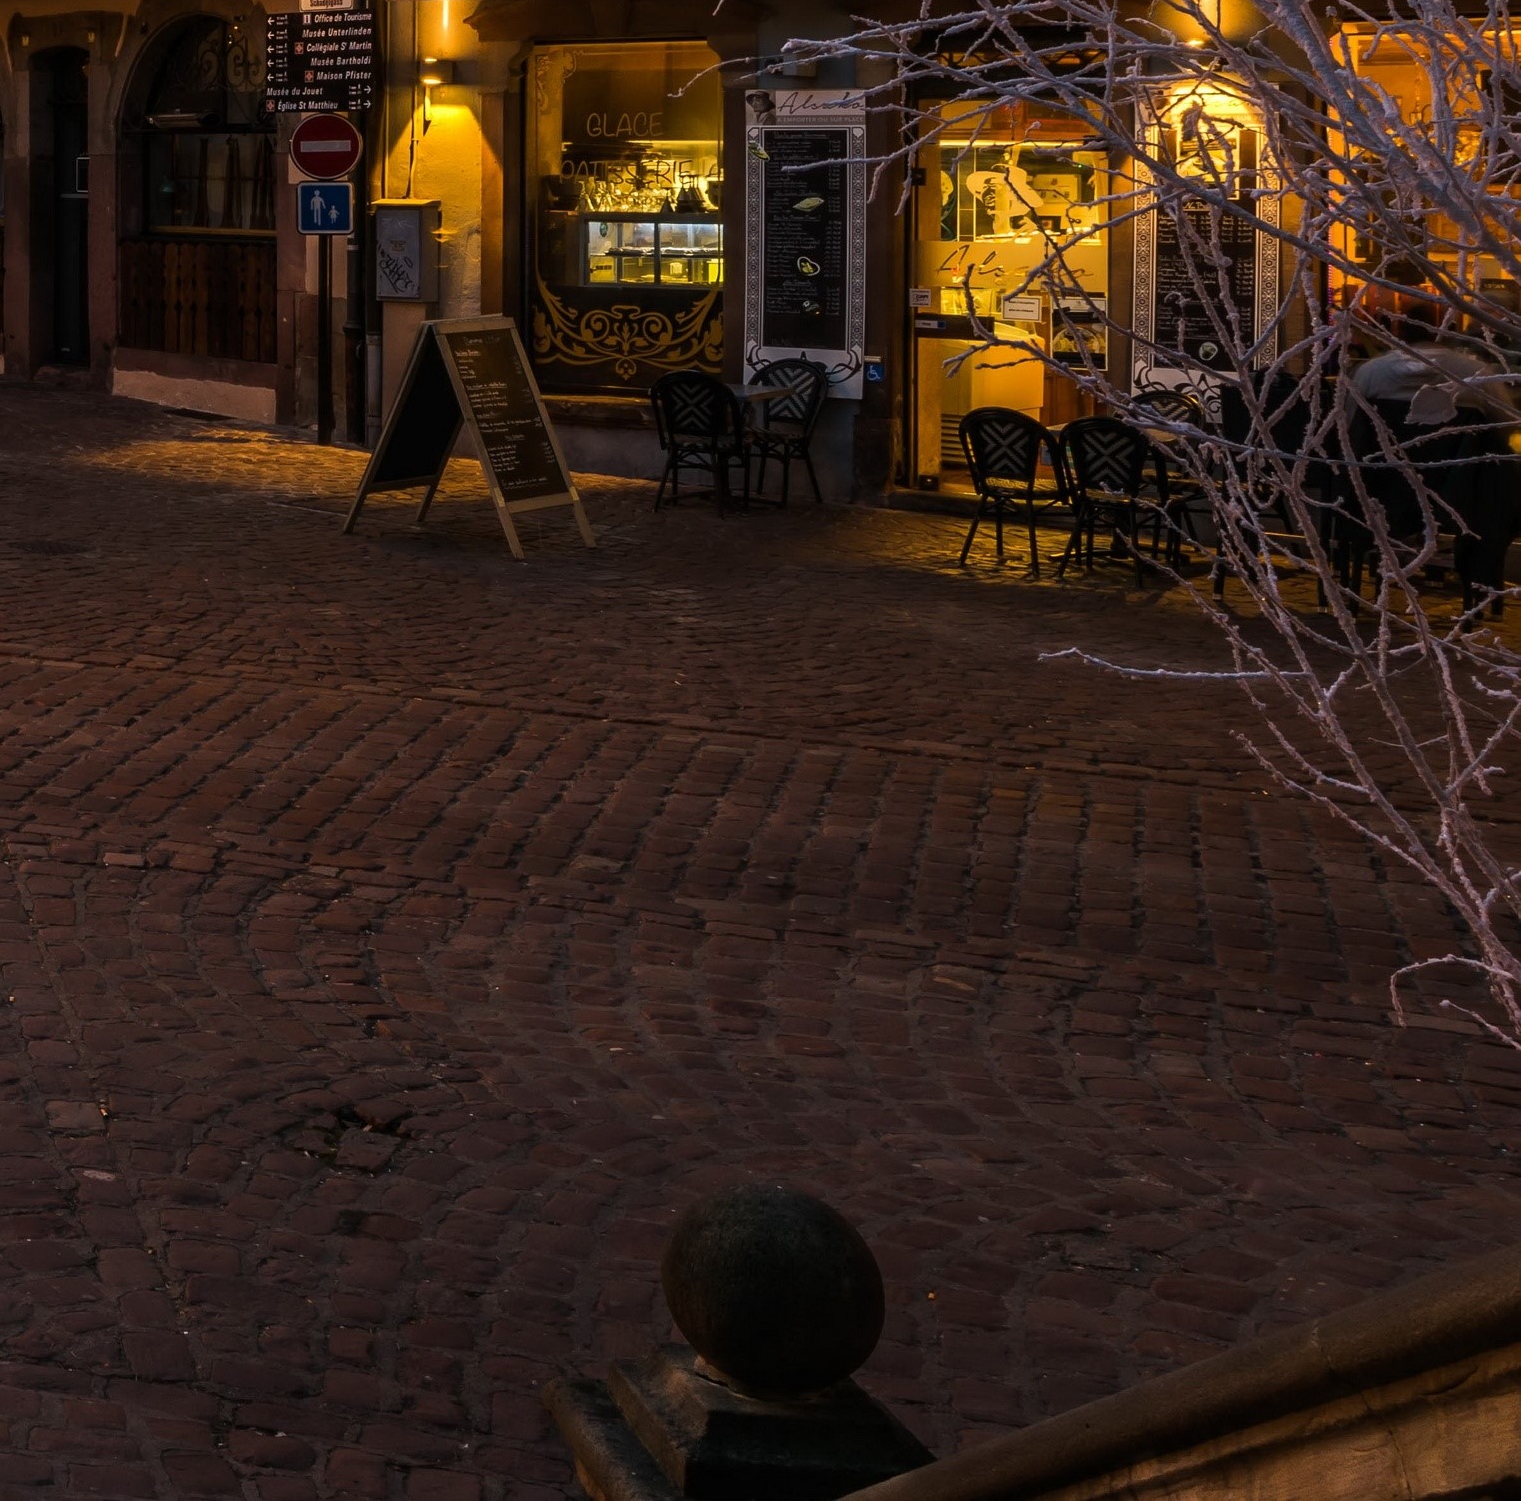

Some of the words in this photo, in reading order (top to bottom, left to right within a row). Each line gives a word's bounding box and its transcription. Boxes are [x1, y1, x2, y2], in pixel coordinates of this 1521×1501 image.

[314, 14, 333, 23] Office
[334, 13, 342, 21] de
[344, 12, 372, 21] Tourisme
[302, 29, 325, 38] Musée
[328, 27, 372, 36] Unterlinden
[306, 42, 339, 53] Collégiale
[349, 41, 372, 50] Martin
[310, 57, 334, 66] Musée
[336, 56, 371, 65] Bartholdi
[316, 71, 343, 80] Maison
[345, 70, 372, 79] Pfister
[266, 87, 289, 96] Musée
[291, 86, 300, 95] du
[302, 86, 323, 95] Jouet
[277, 100, 297, 111] Église
[299, 100, 306, 109] St
[308, 100, 338, 109] Matthieu
[586, 112, 665, 137] GLACE
